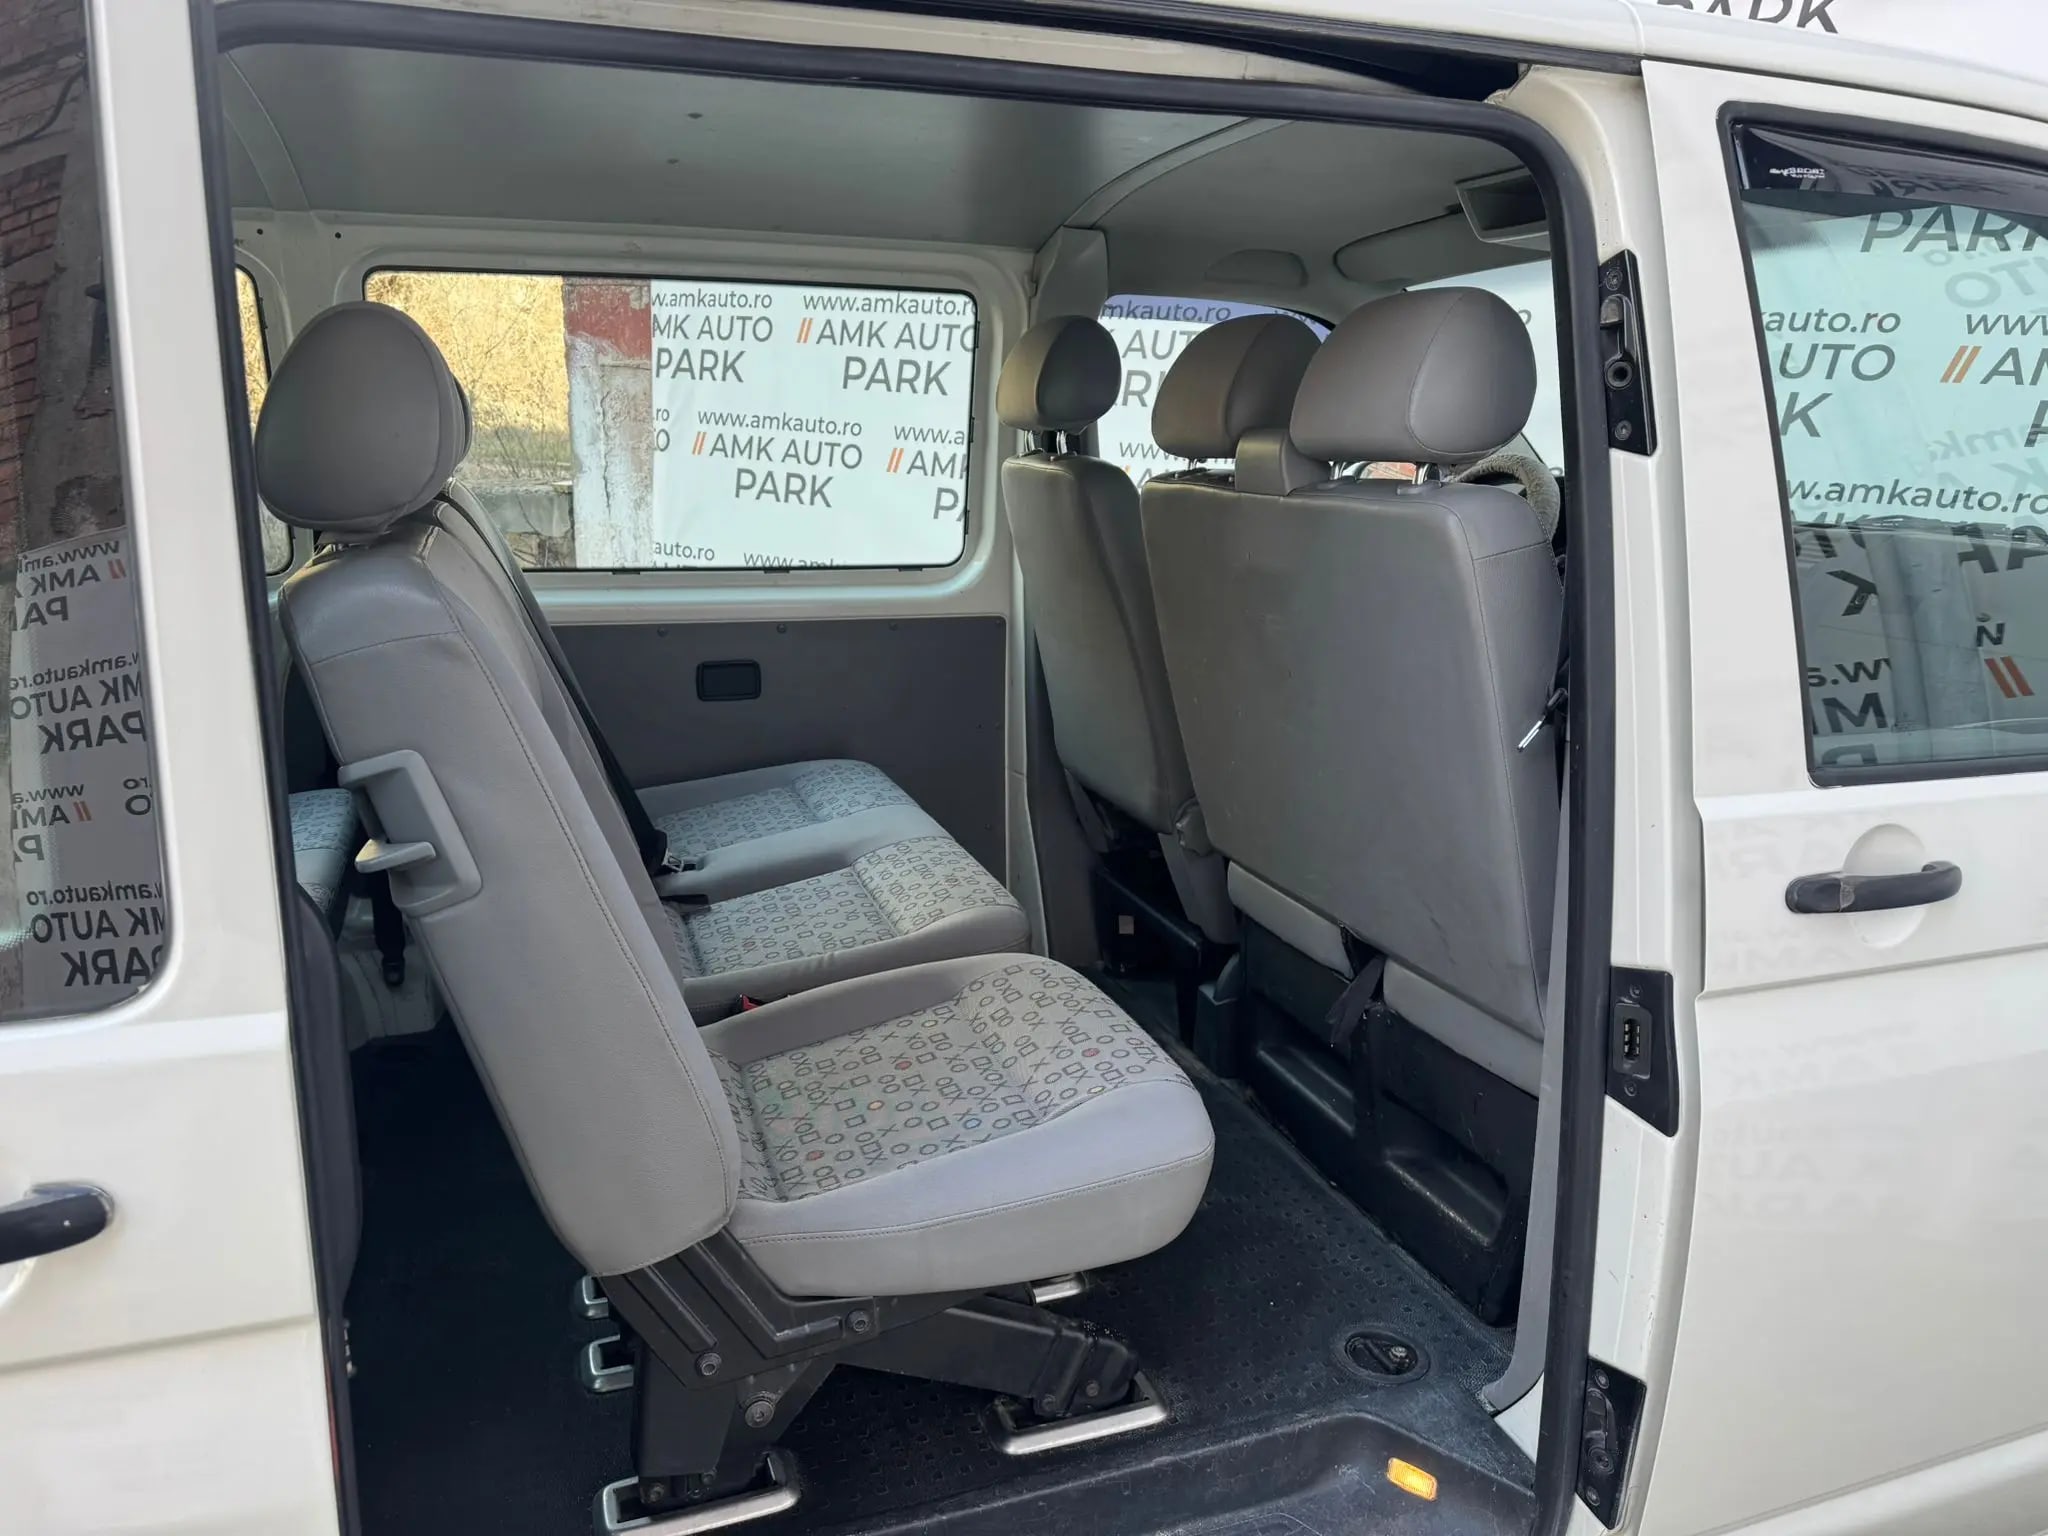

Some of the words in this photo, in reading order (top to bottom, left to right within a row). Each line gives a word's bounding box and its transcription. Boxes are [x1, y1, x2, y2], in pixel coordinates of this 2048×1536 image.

[696, 315, 773, 342] AUTO
[815, 318, 888, 348] AMK
[656, 347, 746, 383] PARK
[842, 355, 952, 396] PARK
[698, 411, 862, 436] www.amkauto.ro
[709, 433, 775, 462] AMK
[781, 438, 863, 470] AUTO
[735, 468, 834, 508] PARK
